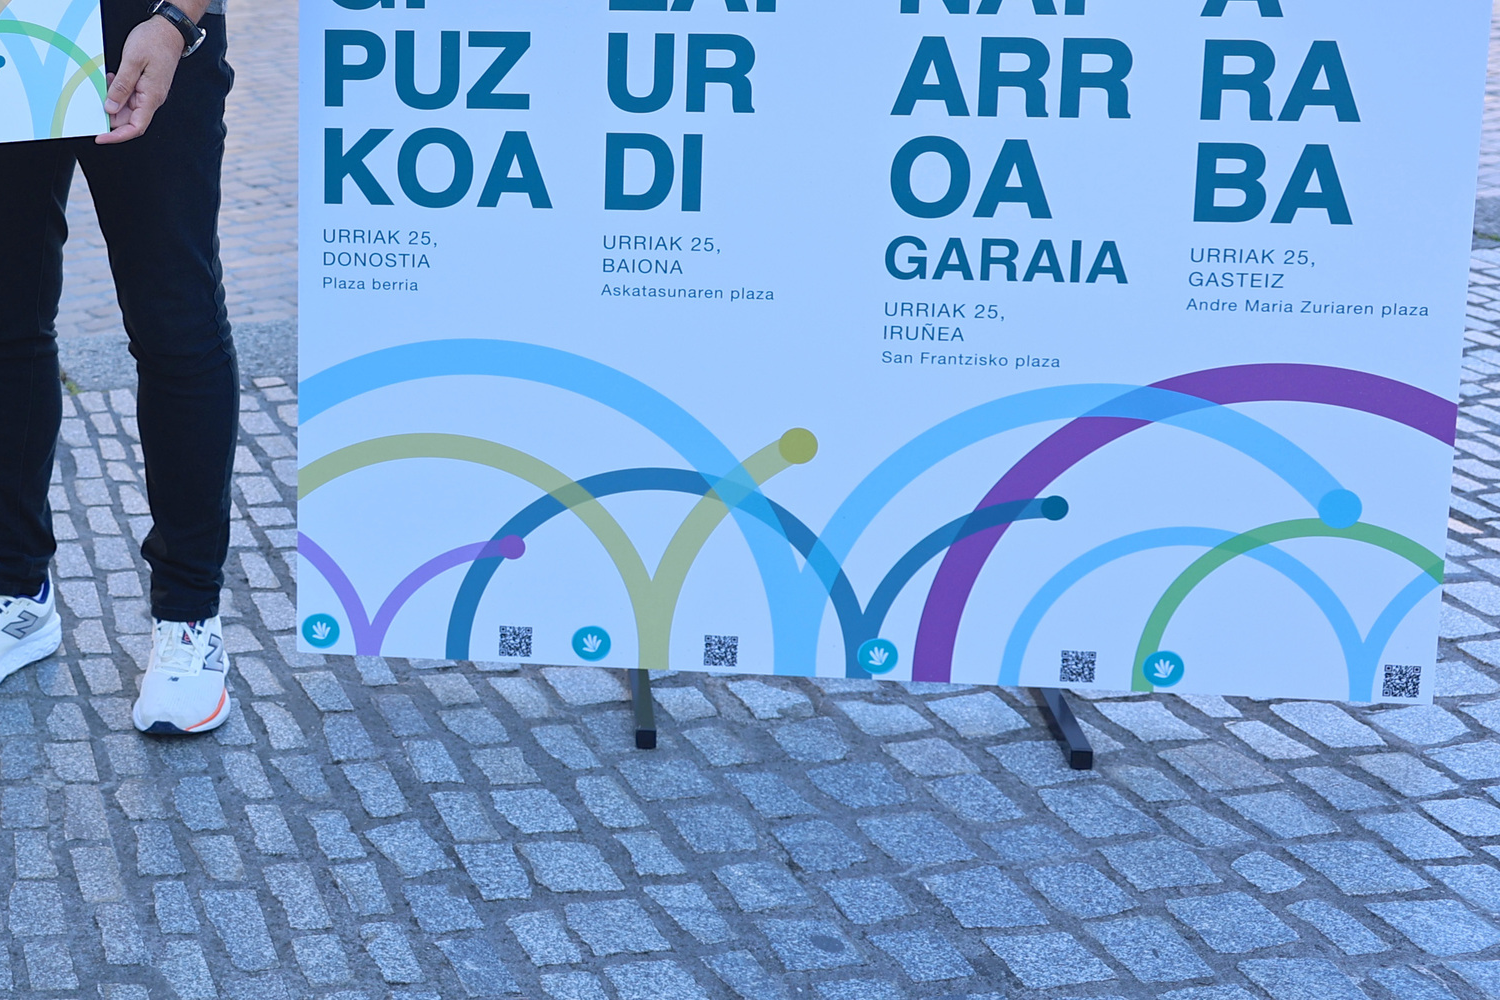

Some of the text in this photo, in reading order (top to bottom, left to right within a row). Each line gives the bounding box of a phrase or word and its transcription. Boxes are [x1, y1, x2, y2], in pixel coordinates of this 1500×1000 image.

[324, 29, 531, 110] PUZ
[607, 32, 756, 114] UR
[890, 36, 1133, 119] ARR
[1200, 39, 1361, 123] RA
[324, 127, 553, 209] KOA
[604, 132, 703, 212] DI
[890, 135, 1052, 219] OA
[1193, 142, 1353, 225] BA
[323, 228, 438, 248] URRIAK 25,
[603, 234, 721, 255] URRIAK 25,
[323, 251, 431, 269] DONOSTIA
[602, 257, 684, 275] BAIONA
[884, 235, 1129, 285] GARAIA
[1190, 247, 1316, 268] URRIAK 25,
[322, 276, 418, 292] Plaza berria
[1188, 271, 1285, 289] GASTEIZ
[601, 283, 775, 302] Askatasunaren plaza
[884, 301, 1005, 322] URRIAK 25,
[1186, 298, 1430, 318] Andre Maria Zuriaren plaza
[883, 322, 965, 342] IRUÑEA
[881, 350, 1061, 370] San Frantzisko plaza
